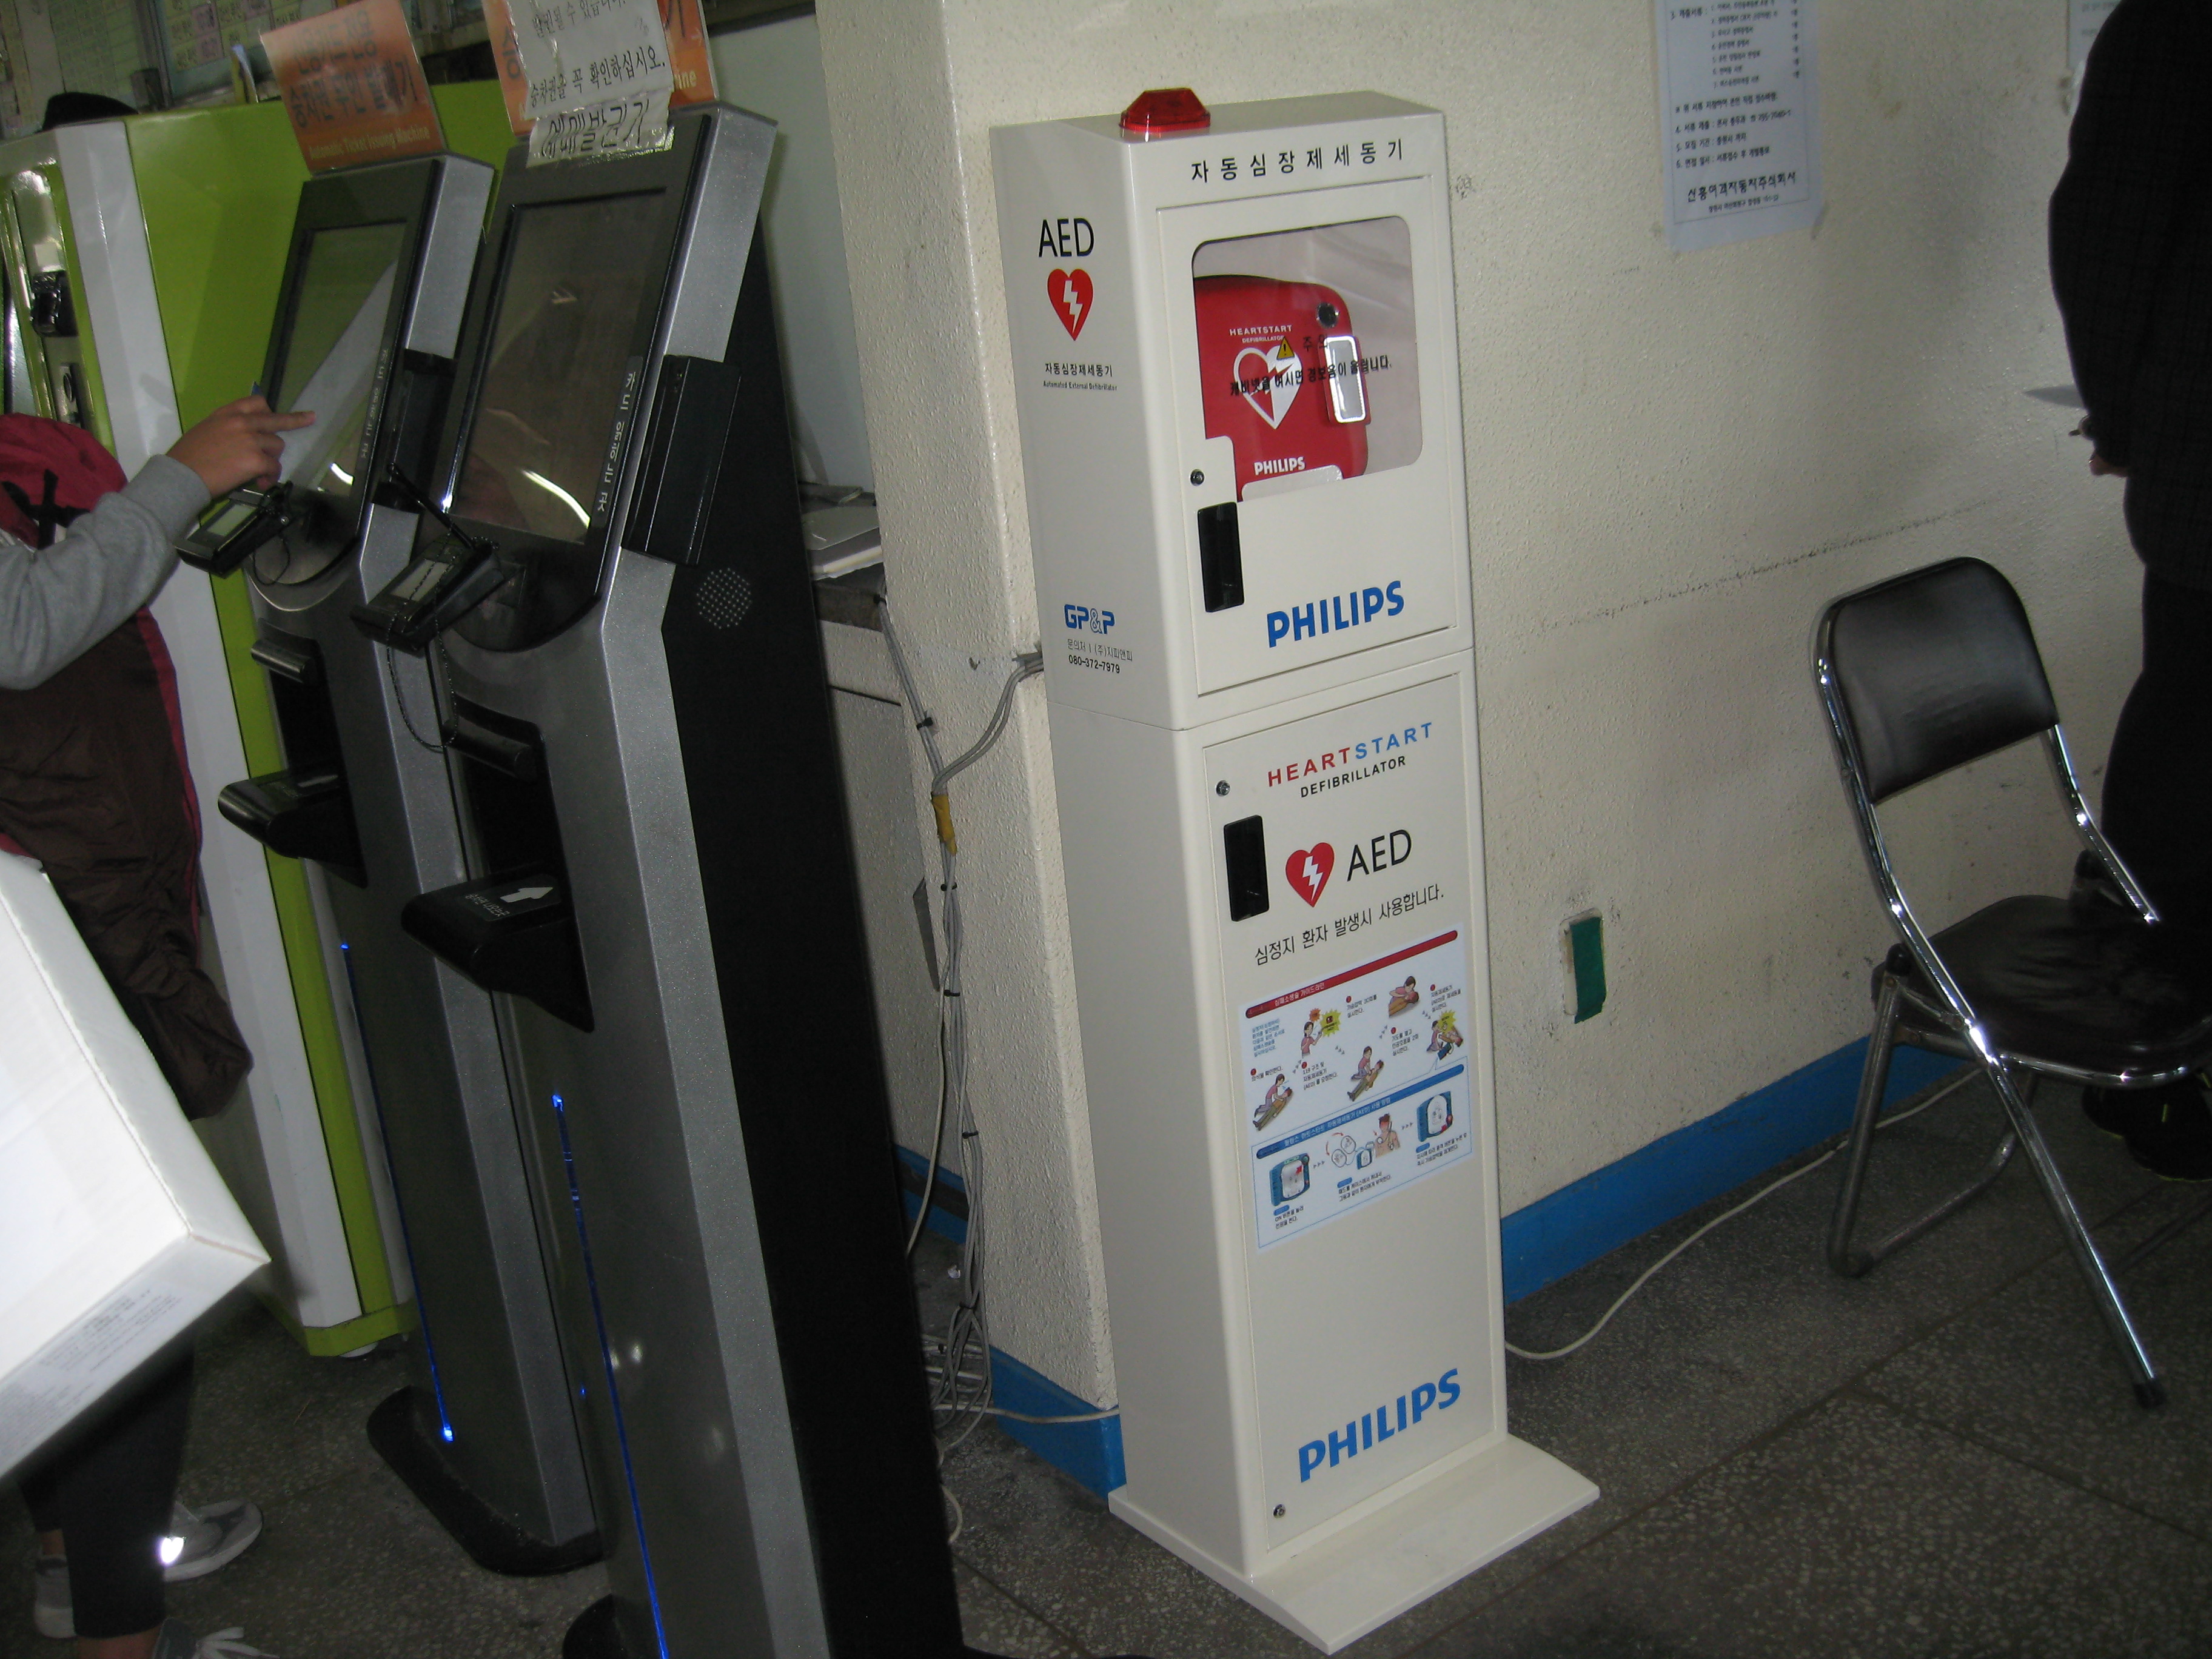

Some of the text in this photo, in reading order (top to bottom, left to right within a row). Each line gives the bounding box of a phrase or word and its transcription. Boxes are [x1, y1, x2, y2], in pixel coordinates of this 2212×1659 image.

[567, 2, 576, 24] 수
[531, 73, 568, 108] 승차권을
[572, 68, 583, 93] 꼭
[590, 45, 666, 90] 확인하십시오.
[1039, 218, 1094, 258] AED
[1229, 324, 1293, 336] HEARTSTART
[1043, 380, 1118, 392] Automated External Defibrillator
[1045, 363, 1113, 377] 자동심장제세동기
[1230, 354, 1392, 396] 캐비넷을 여시면 경보음이 울립니다.
[620, 371, 636, 411] 카드
[1254, 456, 1305, 475] PHILIPS
[597, 492, 608, 512] 곳
[1064, 604, 1115, 634] GP&P
[1267, 580, 1404, 648] PHILIPS
[1067, 638, 1086, 652] 문의처
[1094, 643, 1133, 662] (주)지피앤피
[1068, 654, 1121, 674] 080-372-7979
[1268, 722, 1432, 787] HEARTSTART
[1301, 756, 1406, 798] DEFIBRILLATOR
[1347, 830, 1412, 882] AED
[1255, 883, 1444, 965] 심정지 환자 발생시 사용합니다.
[1298, 1368, 1461, 1483] PHILIPS
